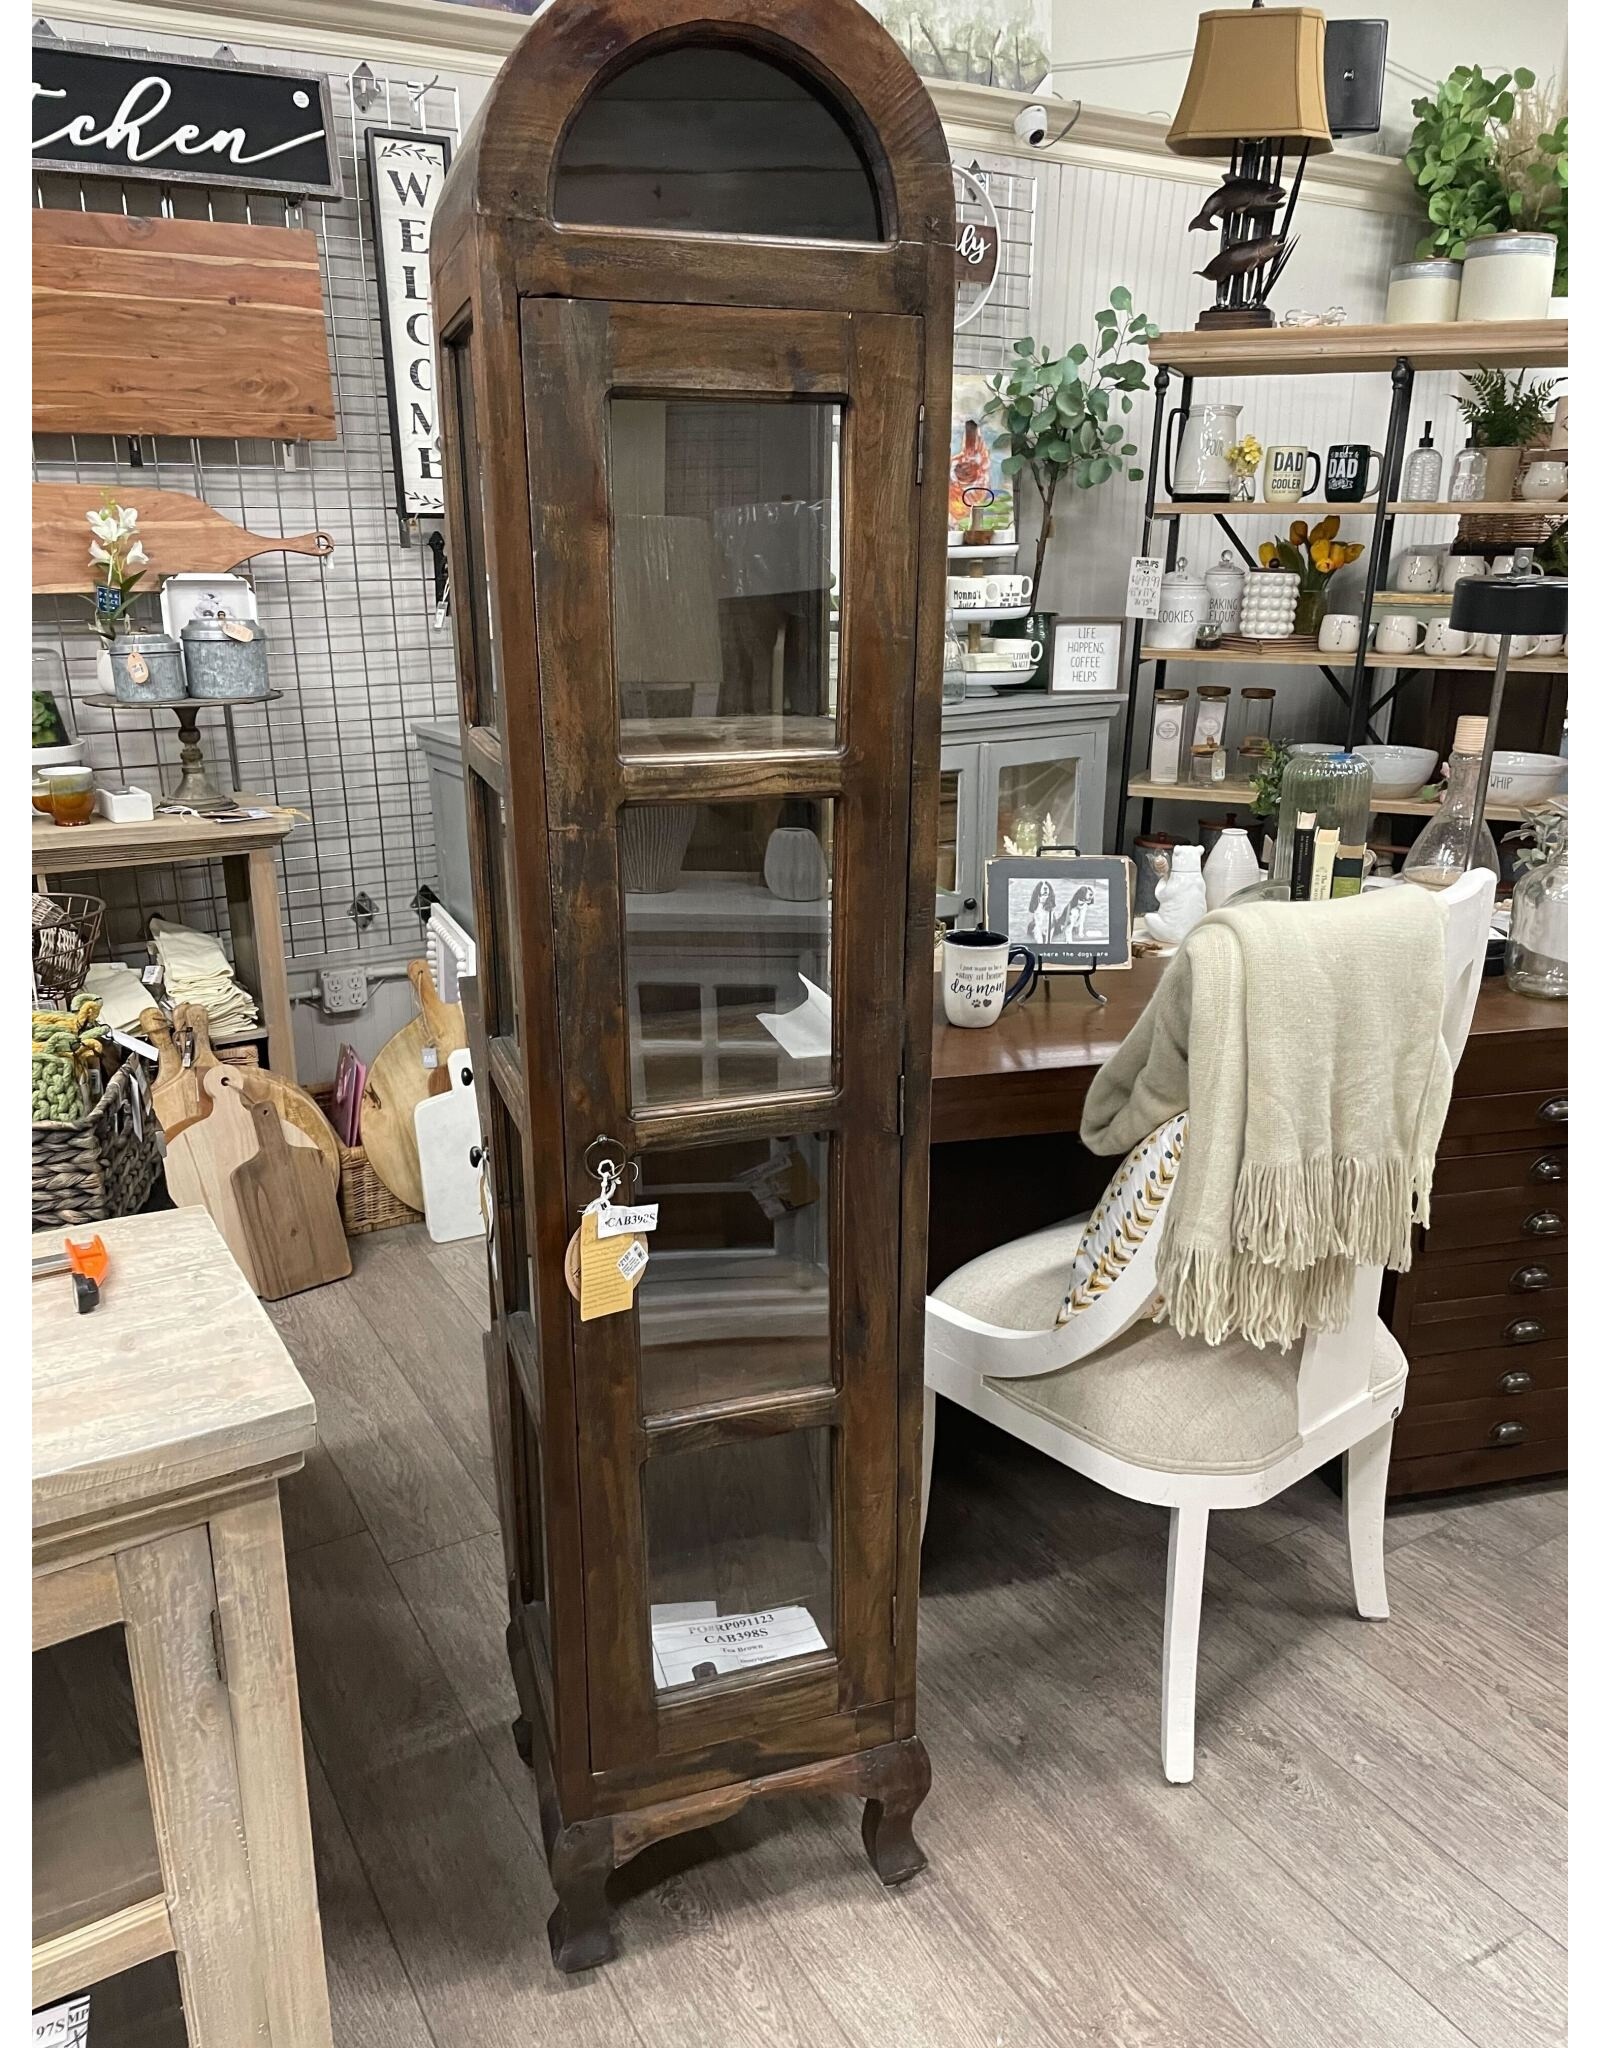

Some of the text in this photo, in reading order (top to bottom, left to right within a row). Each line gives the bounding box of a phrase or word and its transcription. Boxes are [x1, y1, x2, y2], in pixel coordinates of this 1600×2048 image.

[956, 224, 992, 264] ly
[1273, 451, 1303, 472] DAD
[1328, 458, 1358, 478] DAD
[1271, 478, 1301, 490] COOLER
[1209, 598, 1239, 610] BAKING
[1158, 609, 1194, 624] COOKIES
[1208, 610, 1237, 625] FLOUR
[1078, 627, 1097, 639] LIFE
[1070, 656, 1101, 669] COFFEE
[1072, 670, 1098, 683] HELPS
[1490, 775, 1514, 790] WHIP
[950, 978, 1004, 999] dog mom
[688, 1613, 775, 1635] PO#RP091123
[704, 1627, 769, 1644] CAB398S
[737, 1643, 764, 1653] Brown
